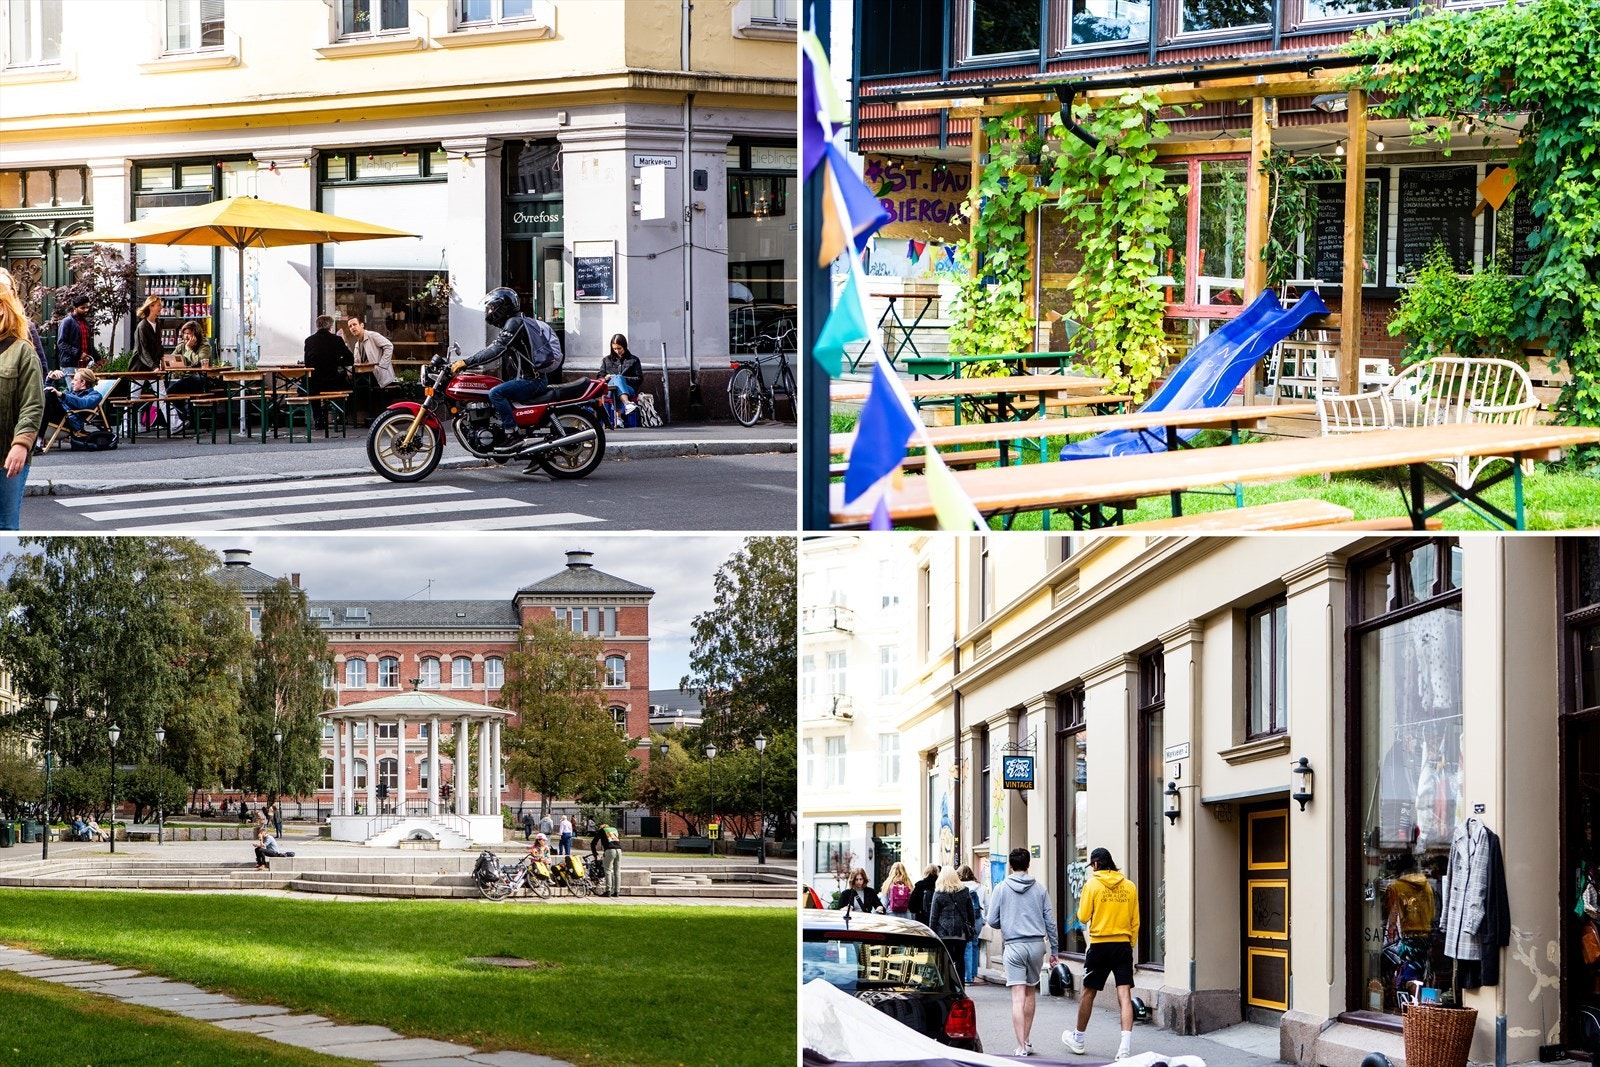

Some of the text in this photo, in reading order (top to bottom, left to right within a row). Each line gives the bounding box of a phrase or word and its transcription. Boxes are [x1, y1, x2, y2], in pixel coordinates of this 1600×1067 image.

[640, 157, 672, 166] Markveien
[756, 149, 793, 168] liebling
[931, 169, 972, 193] PAU
[513, 211, 559, 224] Øvrefoss
[1005, 781, 1033, 789] VINTAGE
